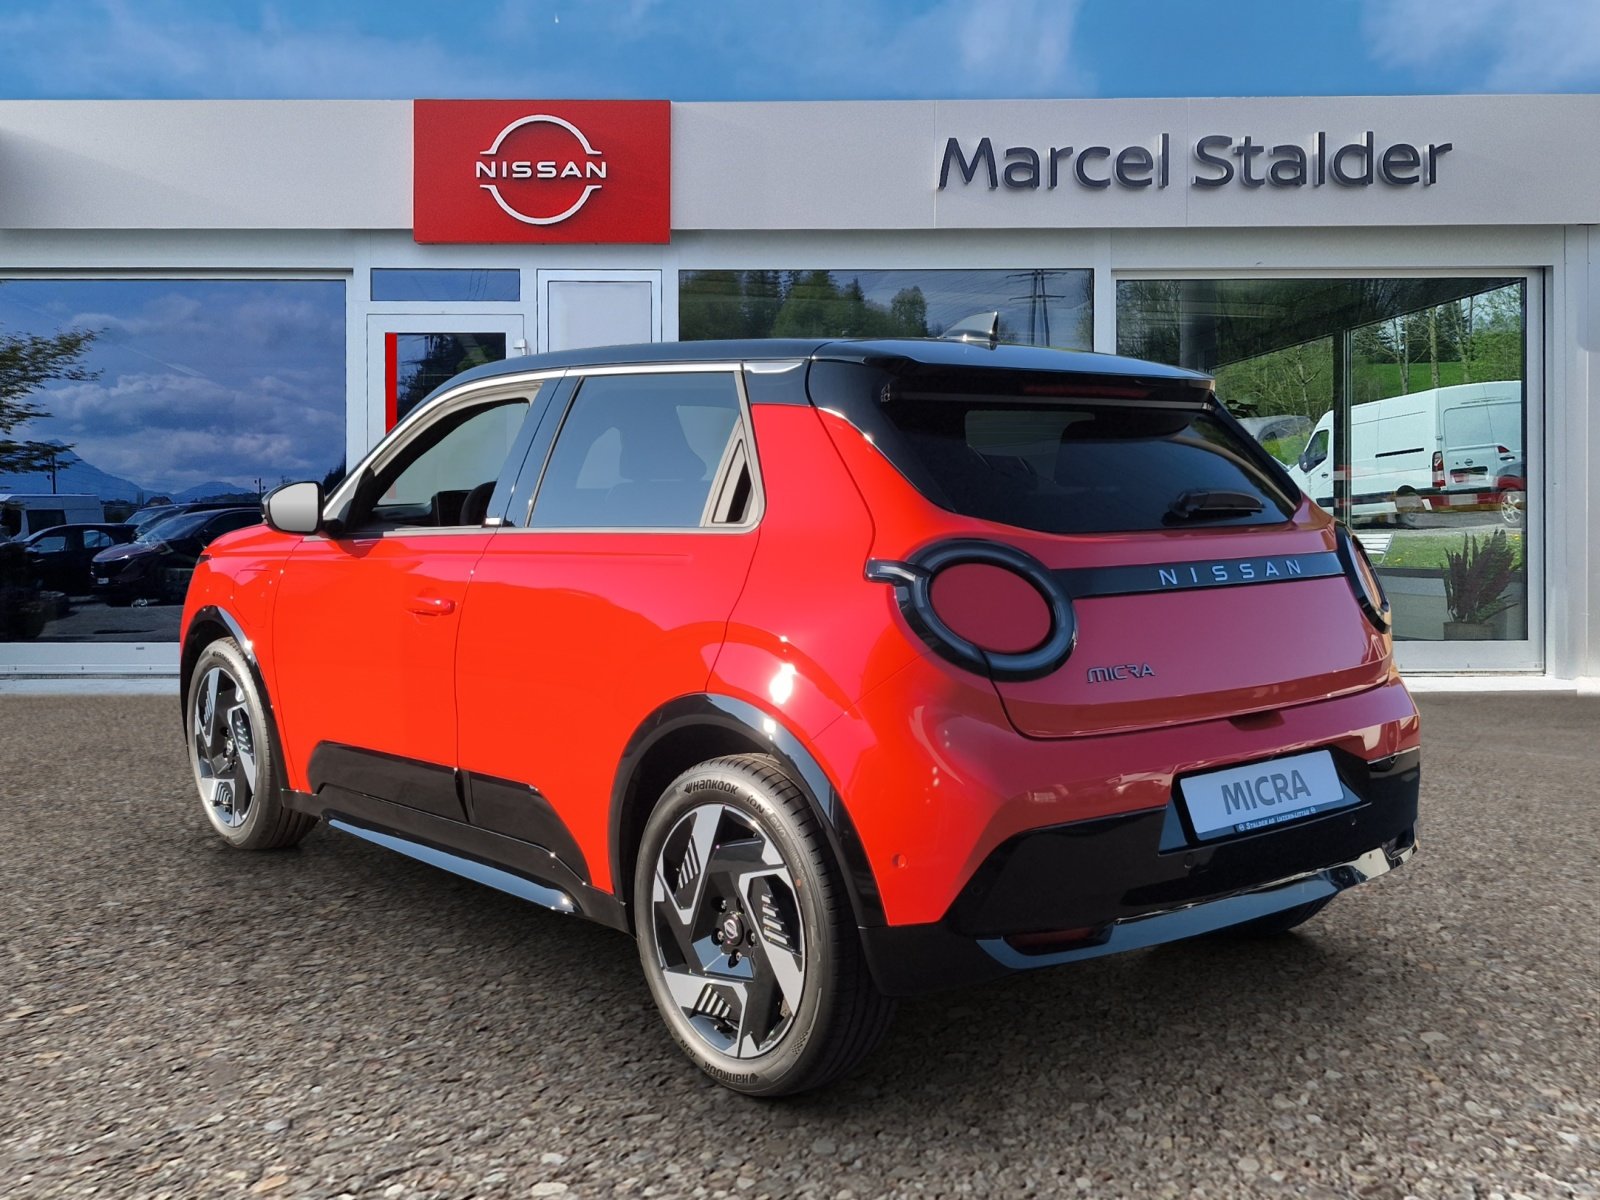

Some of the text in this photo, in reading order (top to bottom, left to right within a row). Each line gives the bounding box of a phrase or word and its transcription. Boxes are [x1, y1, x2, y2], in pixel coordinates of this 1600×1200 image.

[475, 161, 607, 178] NISSAN
[938, 131, 1453, 190] Marcel Stalder
[1158, 559, 1302, 586] NISSAN
[1086, 663, 1156, 683] MICRA
[1221, 769, 1312, 815] MICRA
